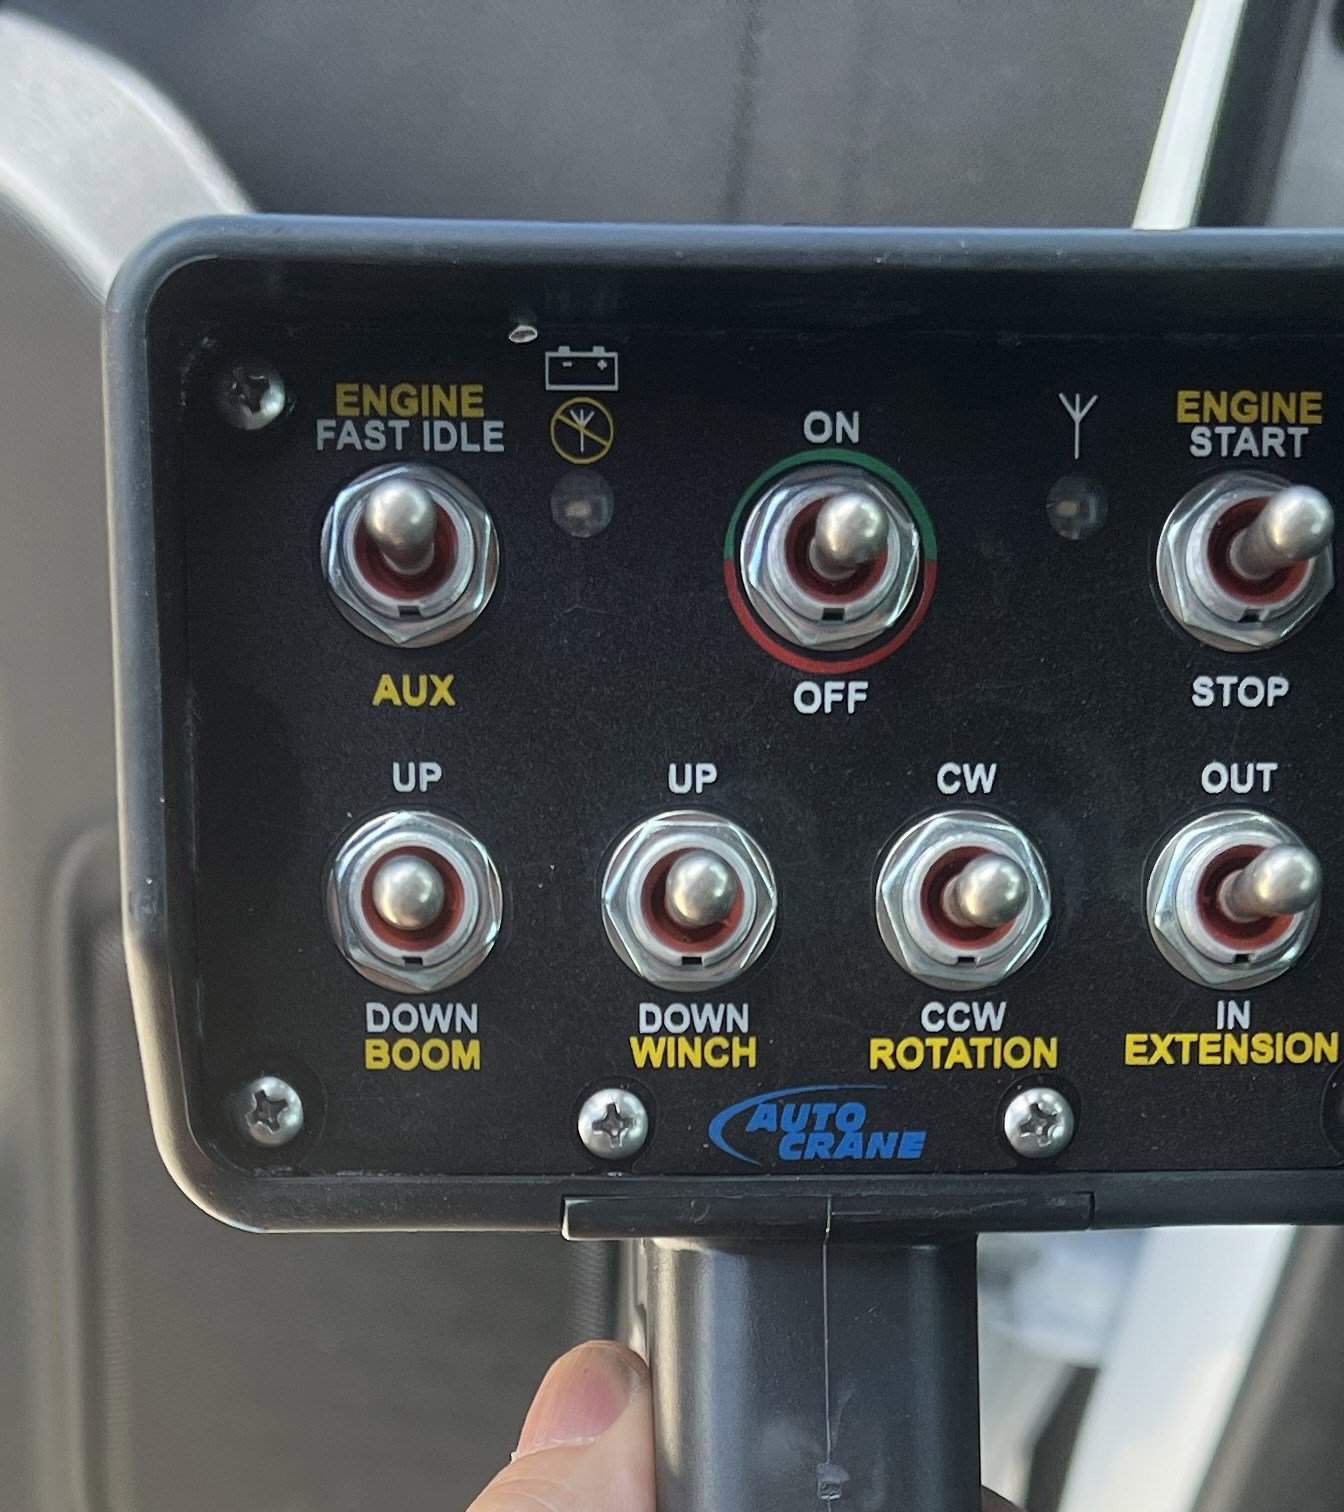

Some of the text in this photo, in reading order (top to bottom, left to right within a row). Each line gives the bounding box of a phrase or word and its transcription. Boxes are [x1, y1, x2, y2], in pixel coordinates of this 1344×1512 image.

[336, 385, 485, 418] ENGINE
[1176, 391, 1323, 424] ENGINE
[316, 419, 505, 453] FAST IDLE
[803, 410, 860, 444] ON
[1189, 426, 1309, 458] START
[372, 673, 456, 707] AUX
[793, 680, 869, 714] OFF
[1191, 675, 1290, 707] STOP
[392, 761, 443, 794] UP
[668, 762, 718, 794] UP
[936, 762, 997, 795] CW
[1201, 762, 1278, 794] OUT
[365, 1002, 479, 1034] DOWN
[638, 1002, 749, 1034] DOWN
[921, 1001, 1007, 1033] CCW
[1216, 1000, 1251, 1030] IN
[364, 1038, 481, 1071] BOOM
[629, 1035, 757, 1069] WINCH
[869, 1036, 1058, 1070] ROTATION
[1124, 1031, 1339, 1066] EXTENSION
[745, 1102, 867, 1132] AUTO
[778, 1131, 927, 1161] CRANE
